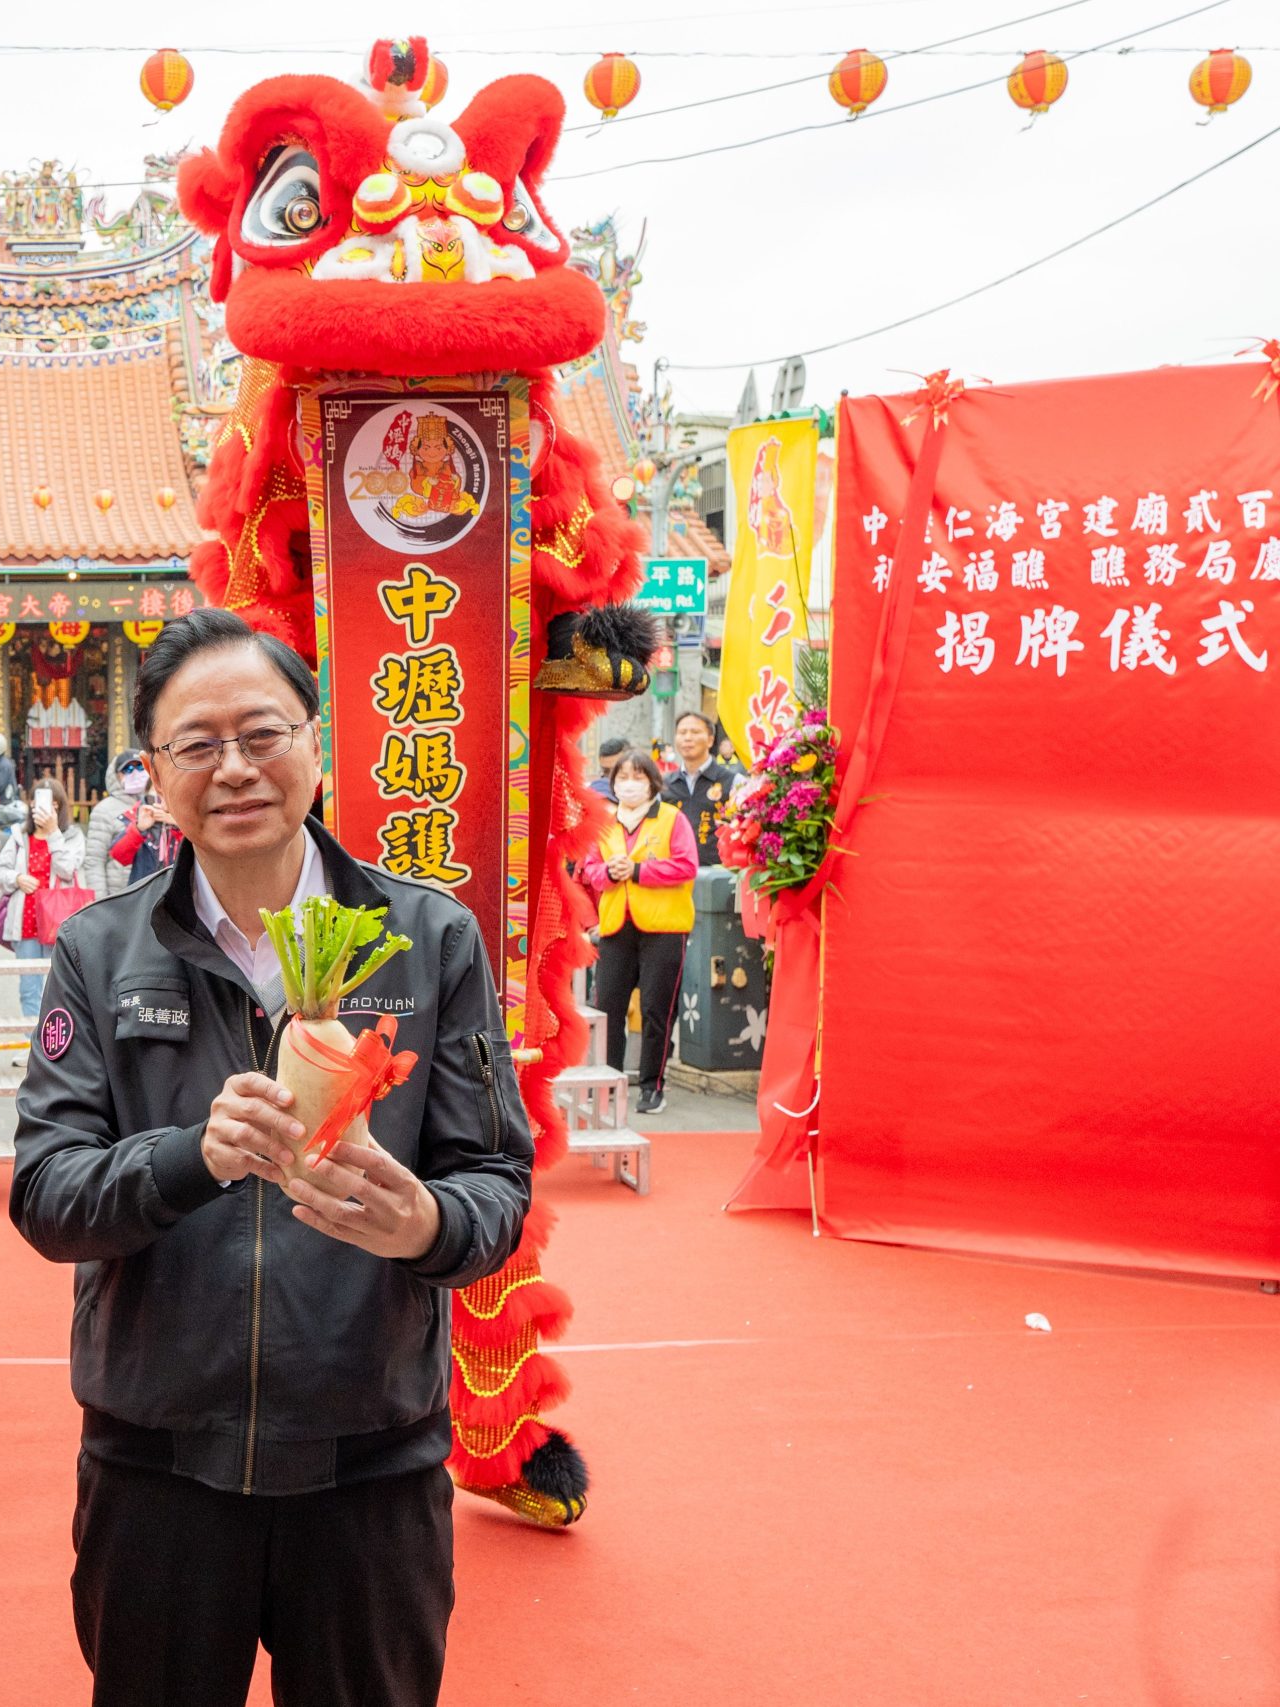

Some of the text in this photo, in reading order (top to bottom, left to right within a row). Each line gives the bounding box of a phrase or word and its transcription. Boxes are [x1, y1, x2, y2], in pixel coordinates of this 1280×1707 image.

[452, 427, 480, 494] Zhongli Matsu
[349, 471, 408, 500] 200
[862, 489, 1274, 546] 中仁海宮建廟貳百
[934, 599, 1269, 678] 揭牌儀式
[121, 996, 140, 1008] 市長
[138, 1007, 189, 1026] 張善政
[340, 997, 415, 1010] TAOYUAN
